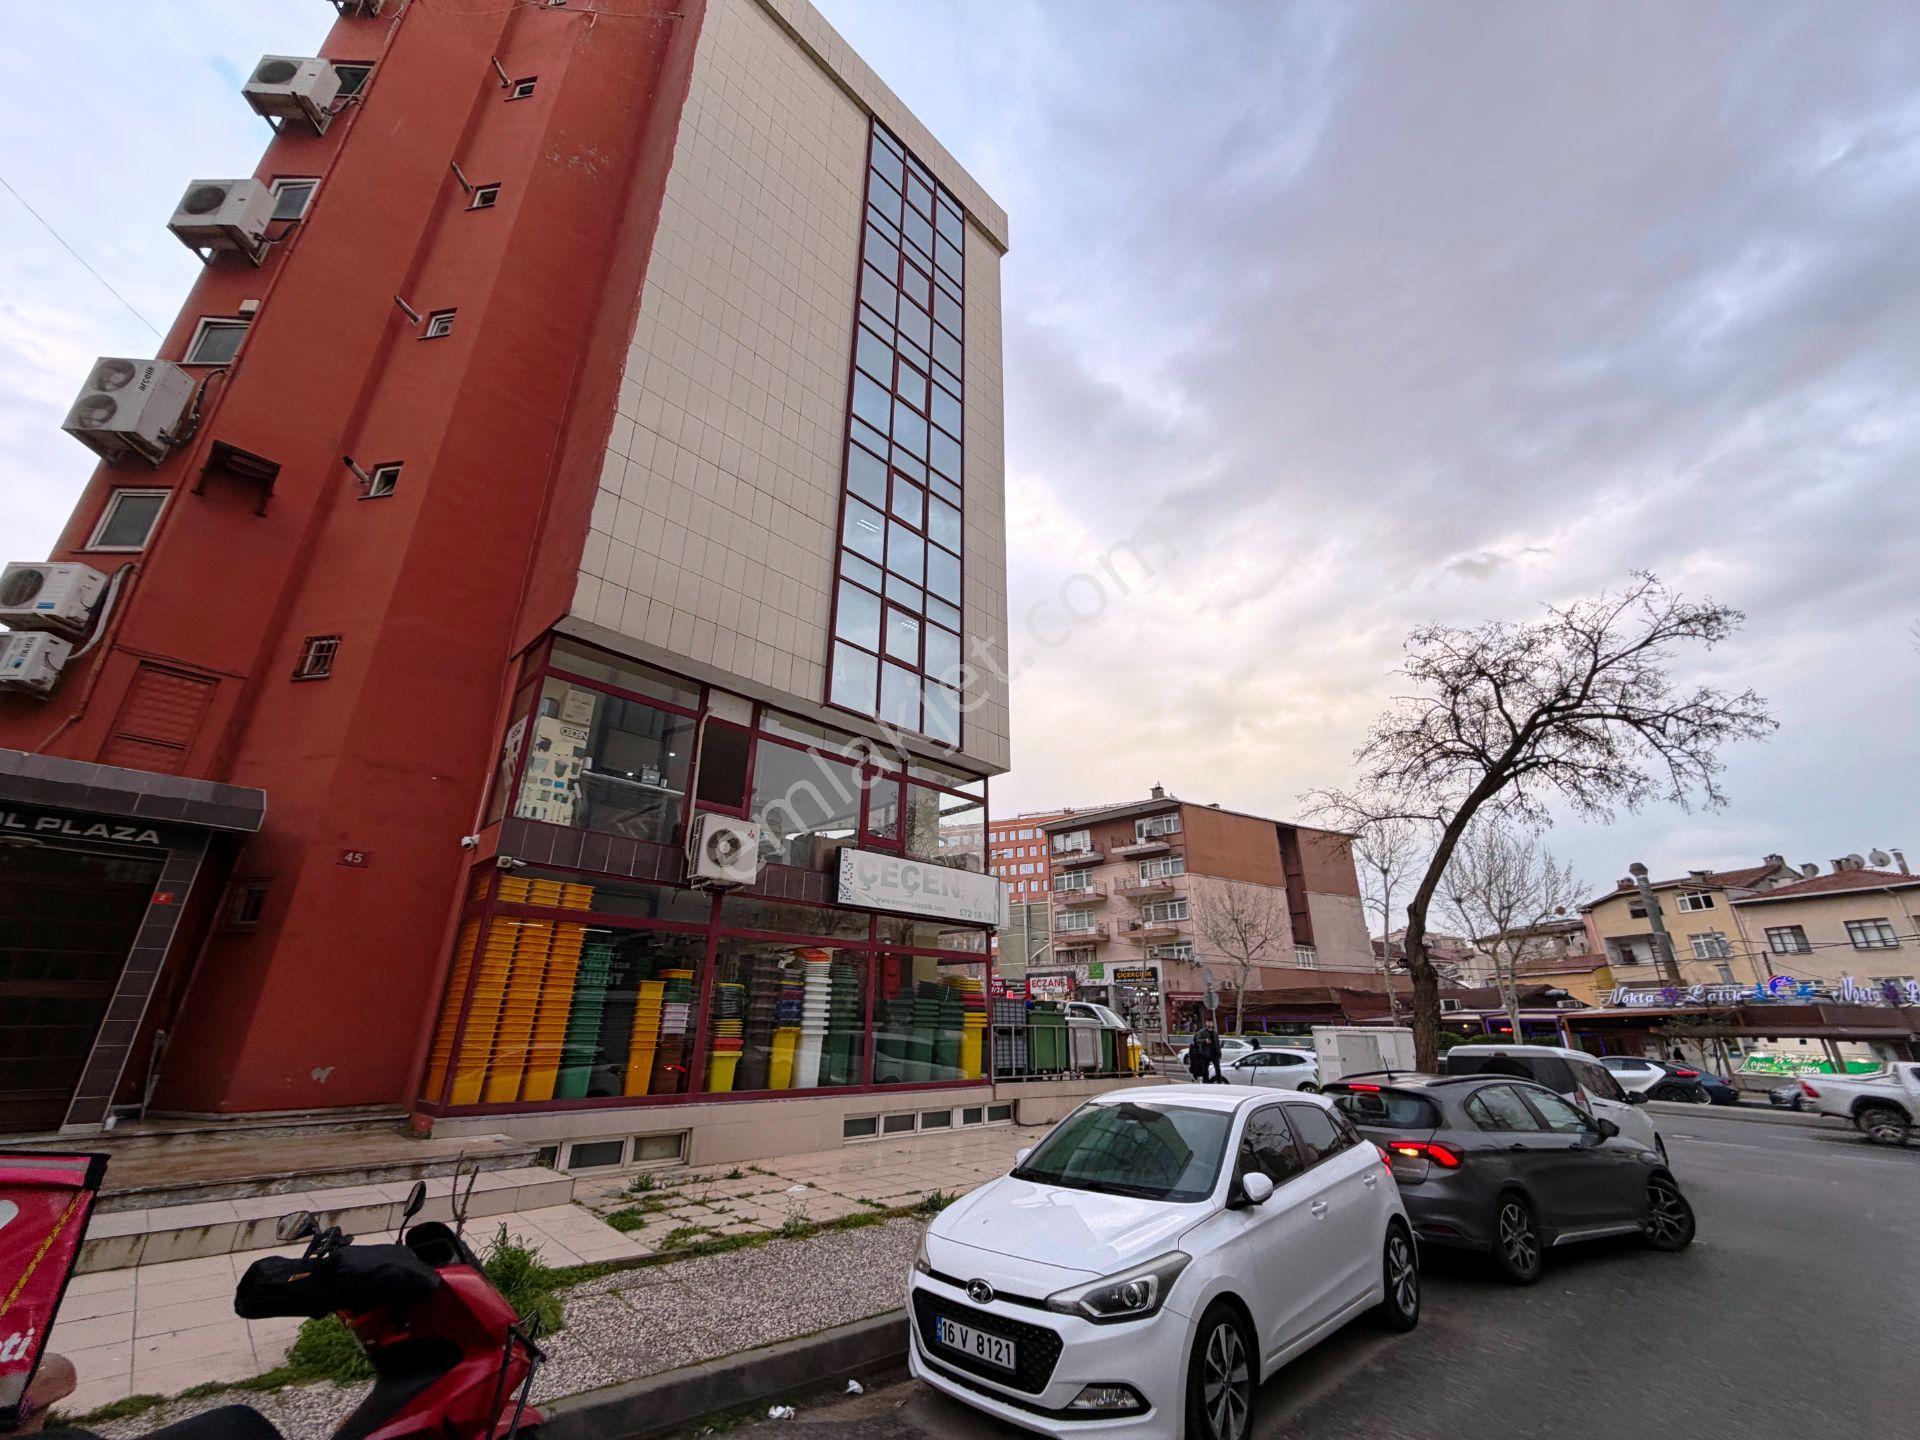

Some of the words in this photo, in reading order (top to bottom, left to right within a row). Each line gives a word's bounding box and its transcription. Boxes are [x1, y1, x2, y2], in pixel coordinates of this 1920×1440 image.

[0, 812, 26, 828] L
[35, 817, 160, 844] PLAZA
[344, 852, 363, 863] 45
[857, 857, 961, 899] ÇEÇEN
[1031, 976, 1066, 988] ECZANE
[0, 1327, 35, 1363] ti
[943, 1321, 956, 1344] 16
[960, 1327, 969, 1349] V
[976, 1333, 1011, 1366] 8121
